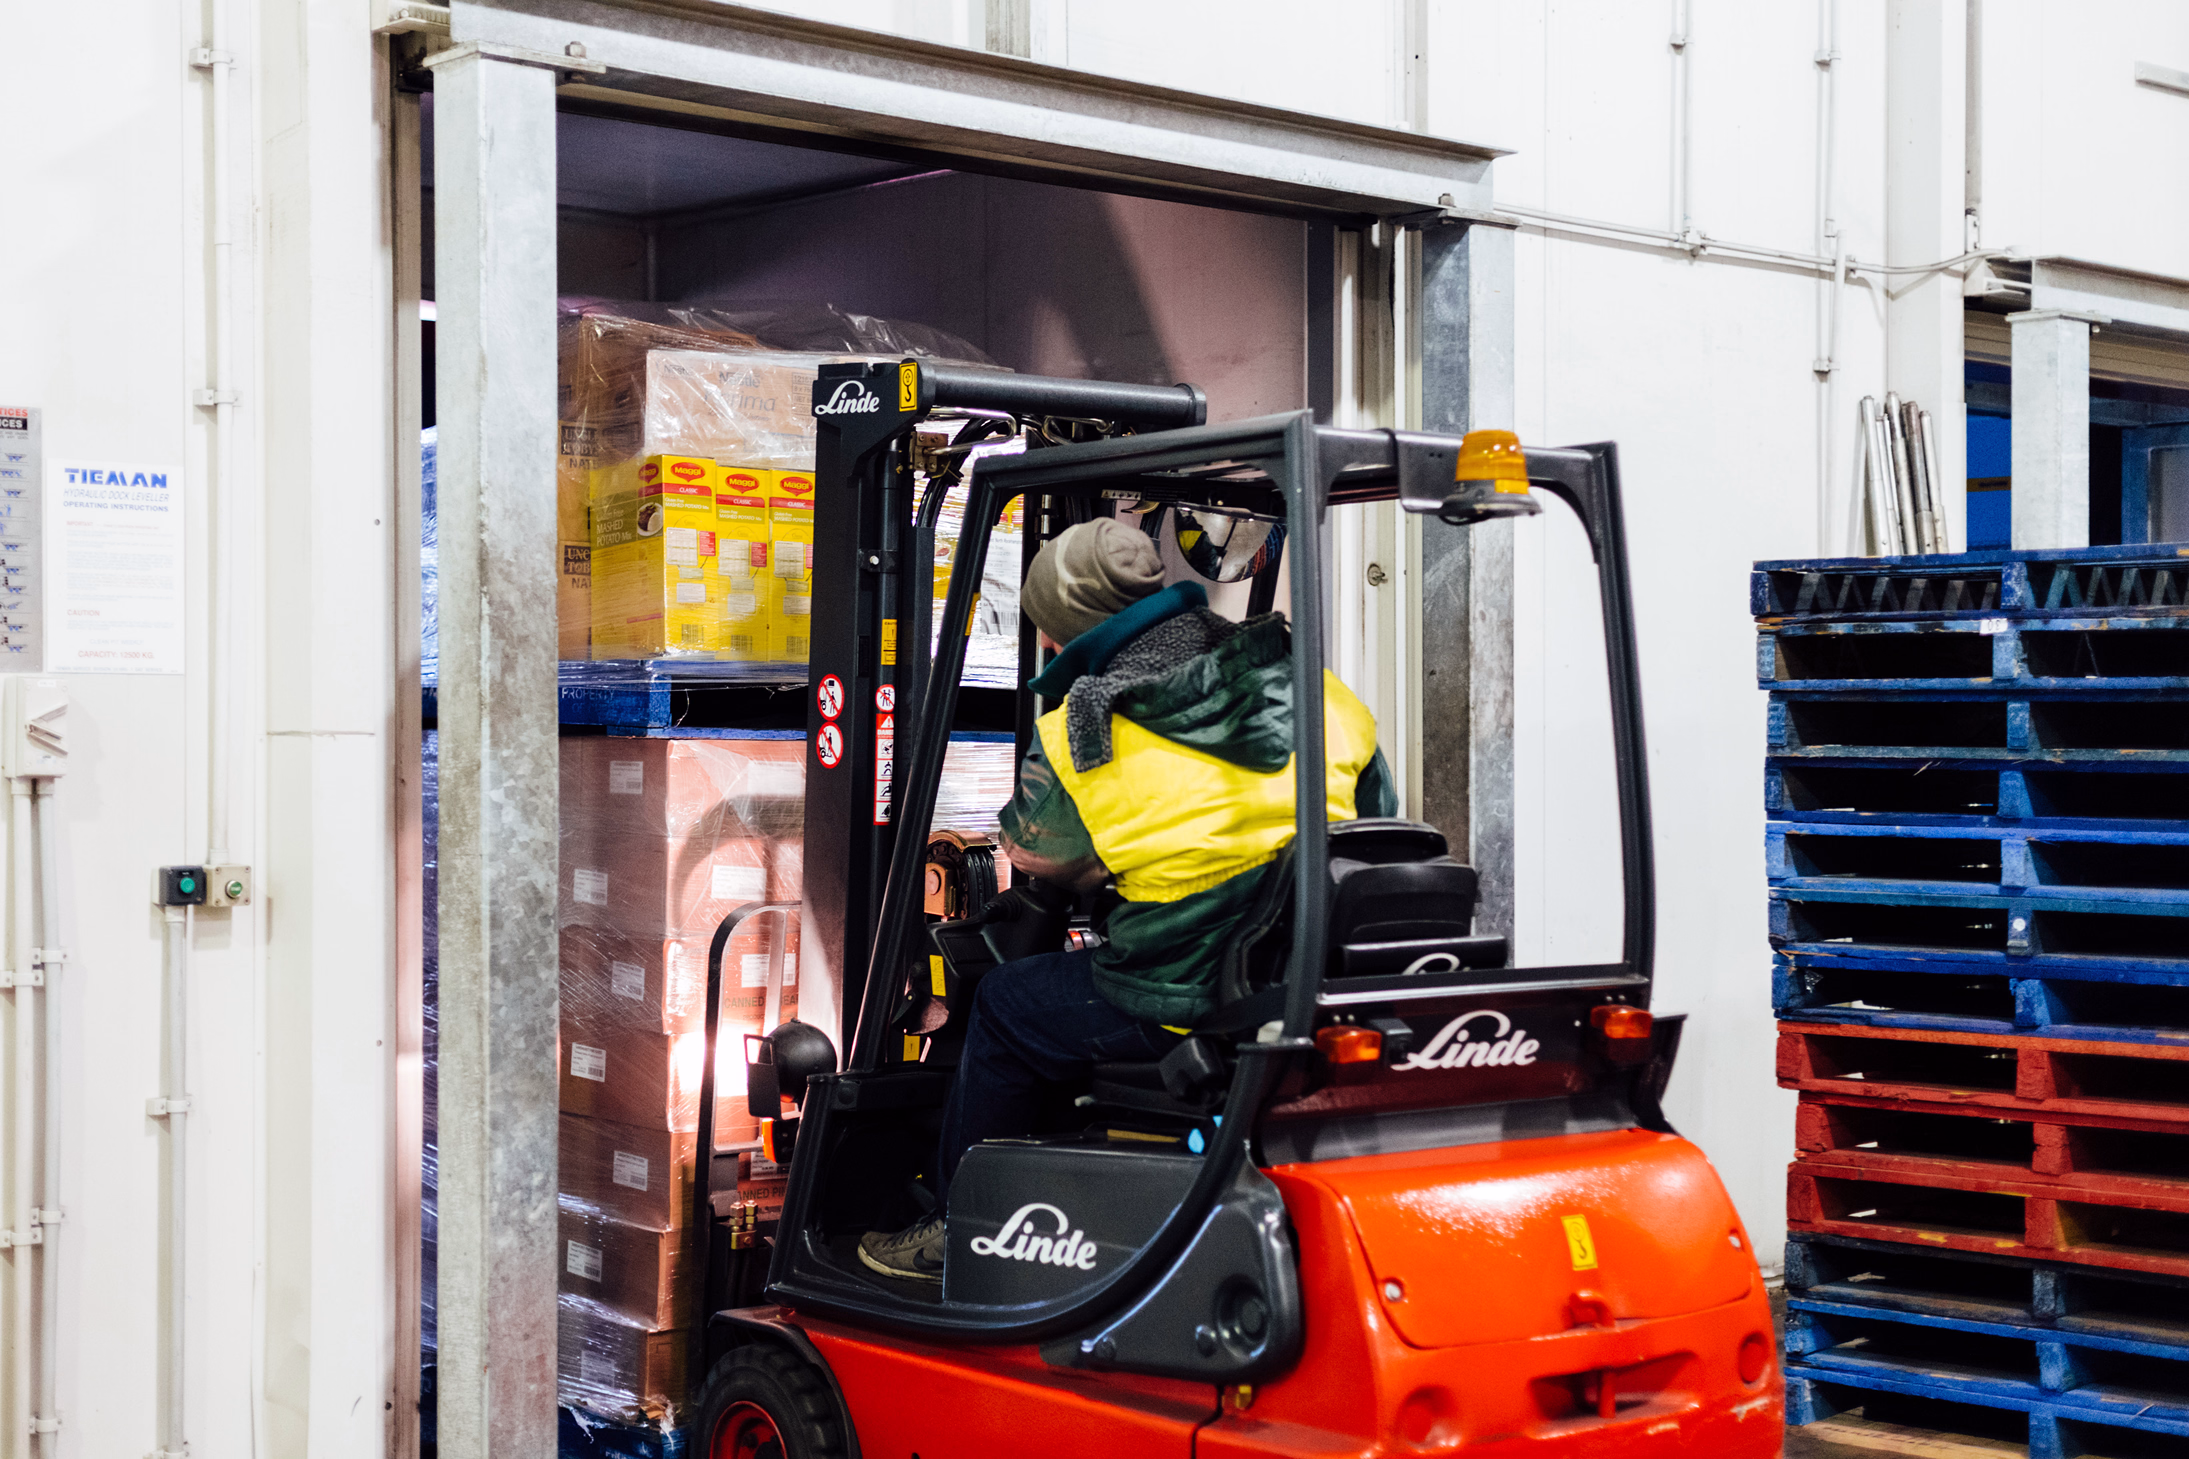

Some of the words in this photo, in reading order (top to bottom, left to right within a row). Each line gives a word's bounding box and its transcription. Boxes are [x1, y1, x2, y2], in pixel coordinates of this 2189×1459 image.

[815, 380, 879, 415] Linde
[674, 466, 702, 476] Maggi
[64, 468, 167, 488] TIEMAN
[729, 478, 755, 487] Maggi
[783, 481, 810, 489] Maggi
[63, 488, 107, 499] HYDRAULIC
[108, 490, 129, 500] DOCK
[131, 492, 169, 502] LEVELLER
[63, 501, 108, 509] OPERATING
[111, 503, 169, 512] INSTRUCTIONS
[597, 519, 624, 534] MASHED
[597, 532, 621, 547] POTATO
[78, 650, 118, 658] CAPACITY:
[562, 687, 614, 700] PROPERTY
[724, 996, 765, 1008] CANNED
[1390, 1009, 1540, 1071] Linde
[970, 1202, 1097, 1270] Linde
